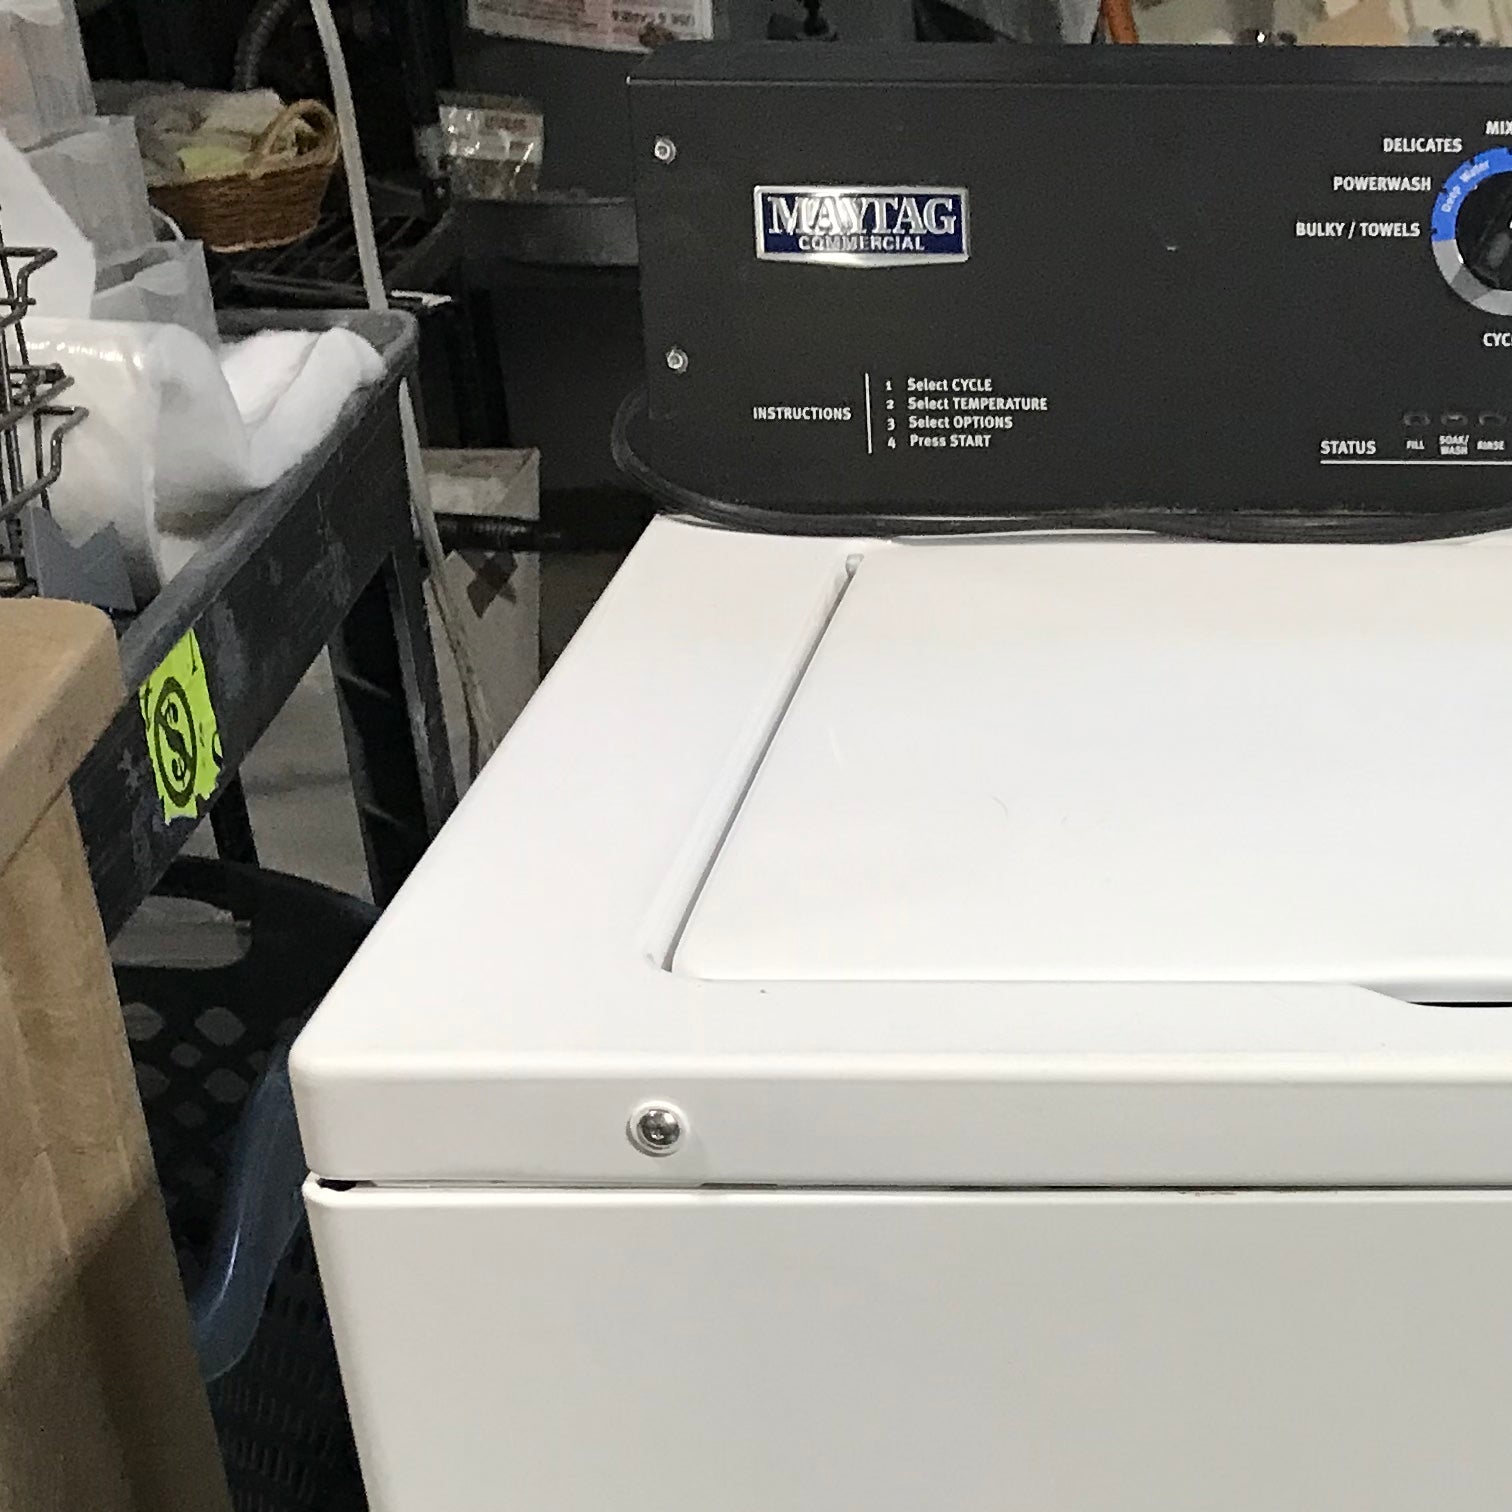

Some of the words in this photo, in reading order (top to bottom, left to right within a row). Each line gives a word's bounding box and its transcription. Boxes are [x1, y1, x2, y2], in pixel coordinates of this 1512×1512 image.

[1383, 137, 1463, 154] DELICATES
[1333, 175, 1432, 192] POWERWASH
[767, 196, 956, 236] MAYTAG
[1295, 221, 1346, 238] BULKY
[1347, 221, 1357, 240] /
[1359, 222, 1421, 238] TOWELS
[798, 235, 925, 252] COMMERCIAL
[885, 380, 893, 391] 1
[907, 376, 949, 392] Select
[951, 378, 993, 392] CYCLE
[885, 399, 895, 410] 2
[907, 396, 950, 411] Select
[952, 396, 1048, 411] TEMPERATURE
[753, 406, 852, 421] INSTRUCTIONS
[887, 417, 896, 431] 3
[908, 415, 950, 429] Select
[953, 415, 1013, 429] OPTIONS
[887, 436, 897, 449] 4
[909, 433, 947, 448] Press
[949, 433, 992, 448] START
[1320, 440, 1377, 455] STATUS
[1406, 438, 1425, 450] FILL
